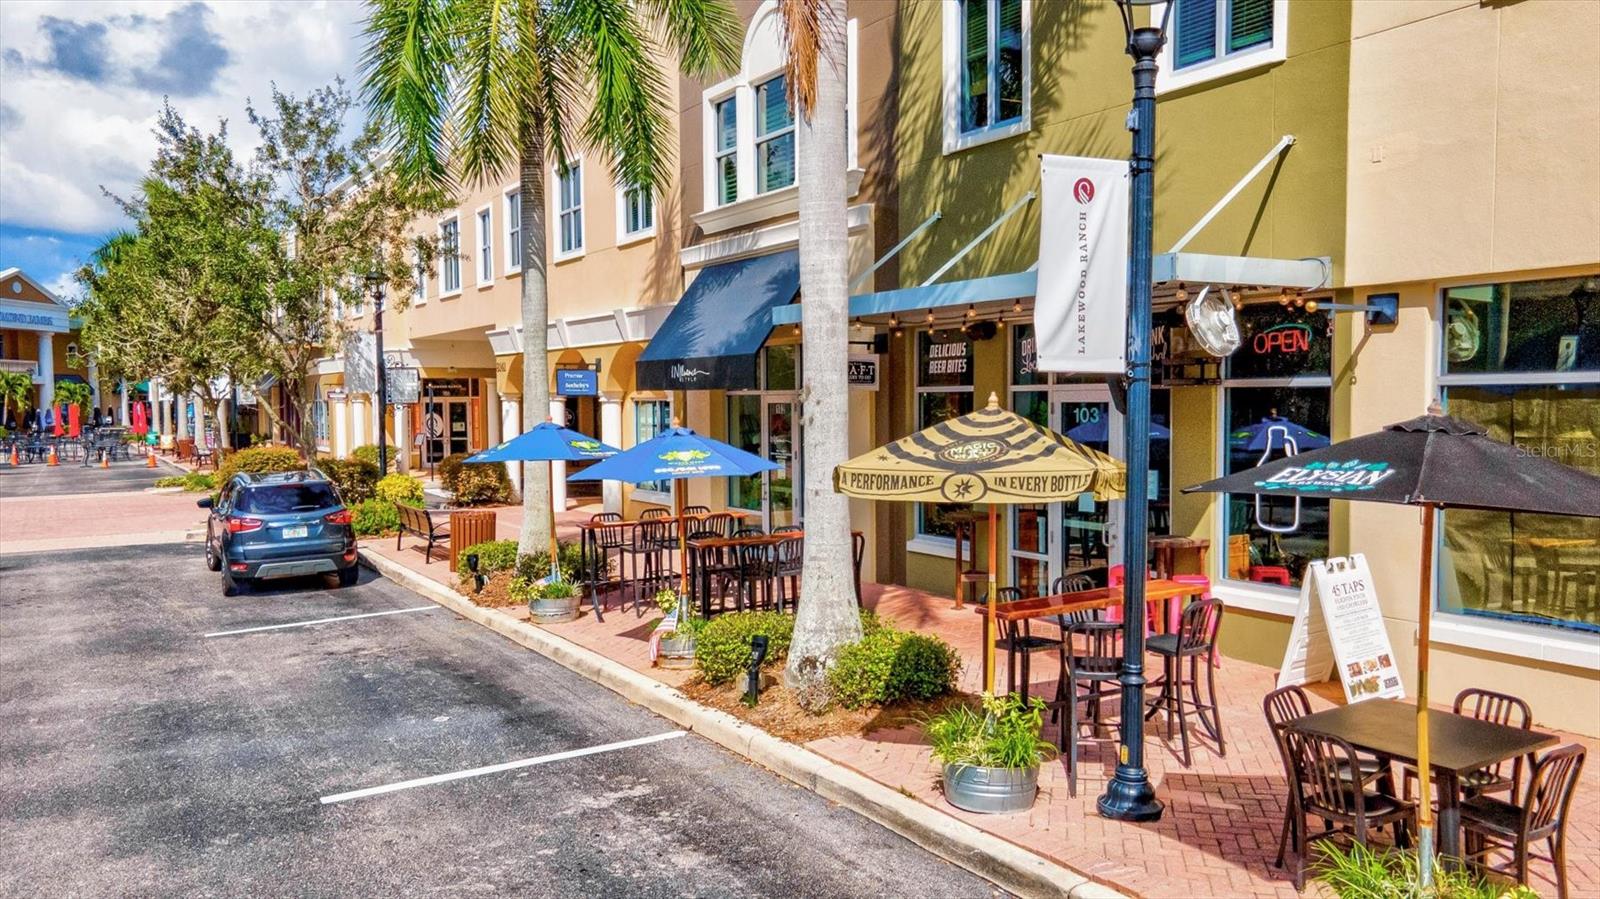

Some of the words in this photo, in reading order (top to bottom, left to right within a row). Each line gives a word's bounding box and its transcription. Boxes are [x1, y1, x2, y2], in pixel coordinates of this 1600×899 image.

[1078, 212, 1088, 263] RANCH
[1077, 269, 1088, 354] LAKEWOOD
[929, 342, 967, 358] DELICIOUS
[1021, 338, 1036, 357] DRI
[1253, 329, 1310, 354] OPEN
[929, 360, 947, 374] BEER
[946, 359, 968, 373] BITES
[1073, 407, 1100, 424] 103
[950, 441, 997, 457] MAGIC
[841, 472, 848, 486] A
[850, 472, 935, 491] PERFORMANCE
[994, 476, 1007, 488] IN
[1009, 476, 1049, 492] EVERY
[1050, 474, 1091, 492] BOTTLE
[1266, 467, 1396, 486] ELYSIAN
[1331, 584, 1341, 597] 45
[1341, 579, 1366, 595] TAPS
